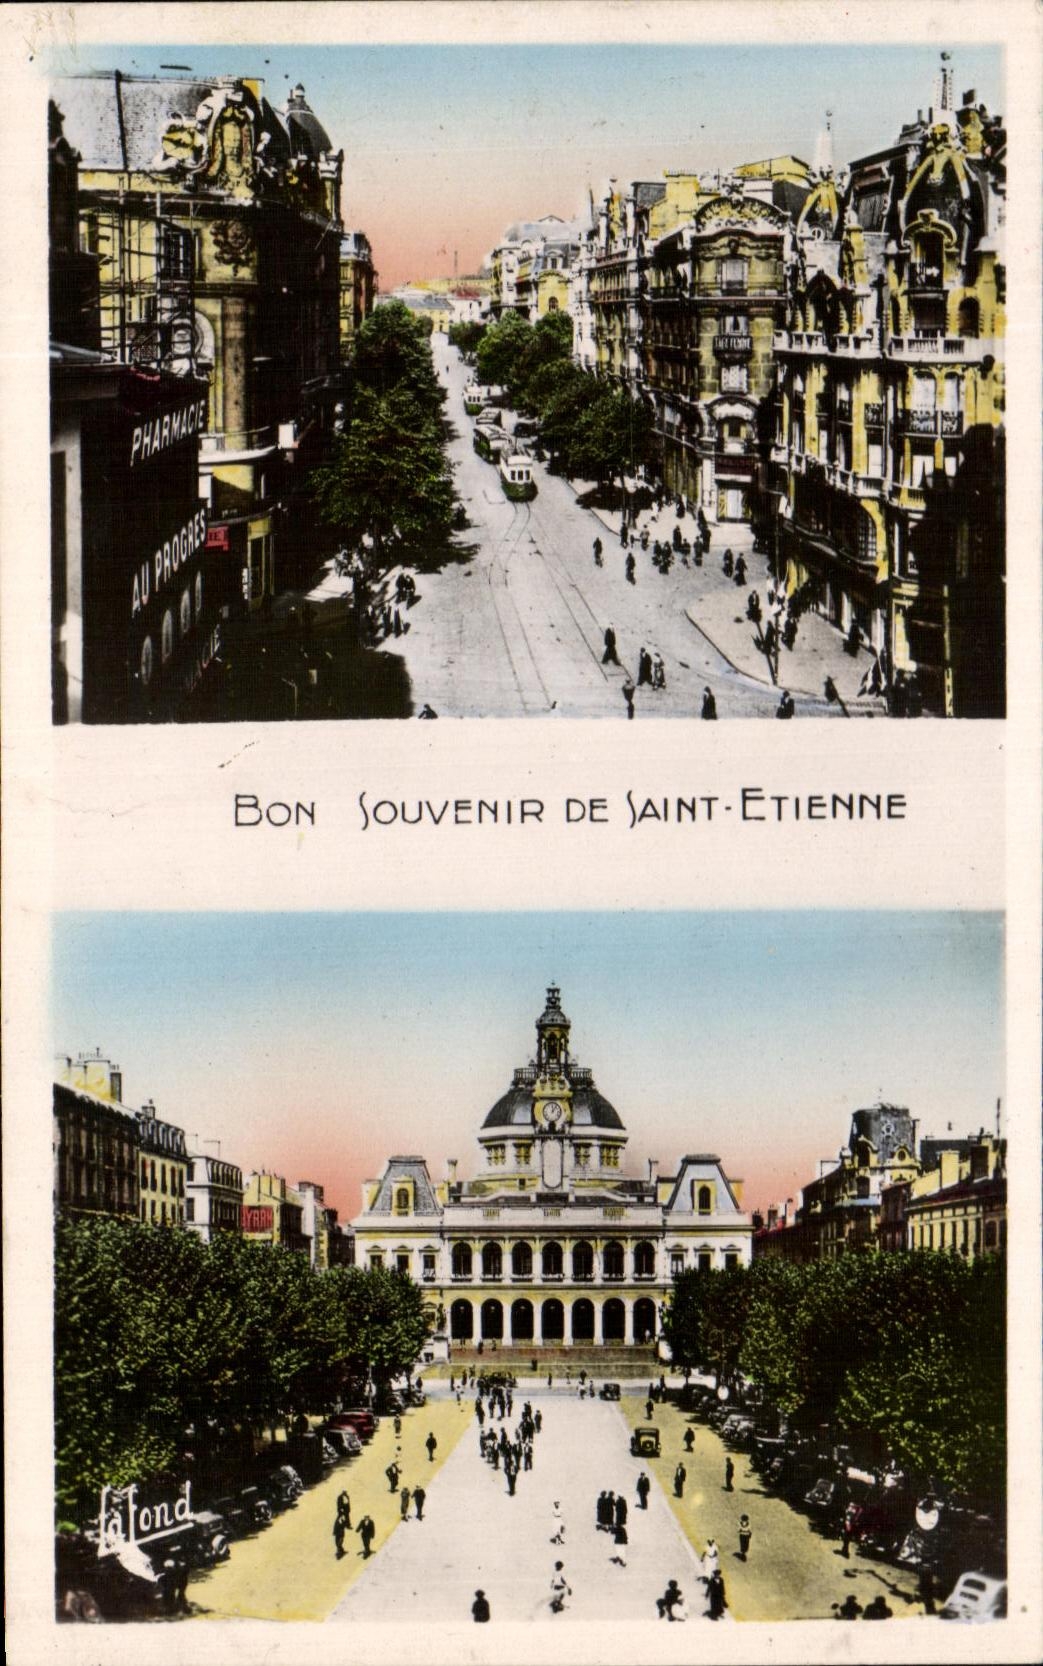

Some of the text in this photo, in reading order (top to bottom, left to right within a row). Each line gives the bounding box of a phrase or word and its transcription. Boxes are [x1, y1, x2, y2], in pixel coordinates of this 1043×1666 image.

[130, 400, 204, 467] PHARMACIE
[131, 560, 150, 619] AU
[154, 507, 207, 592] PROGRES
[234, 794, 315, 827] BON
[359, 791, 544, 830] SOUVENIR
[566, 798, 609, 823] DE
